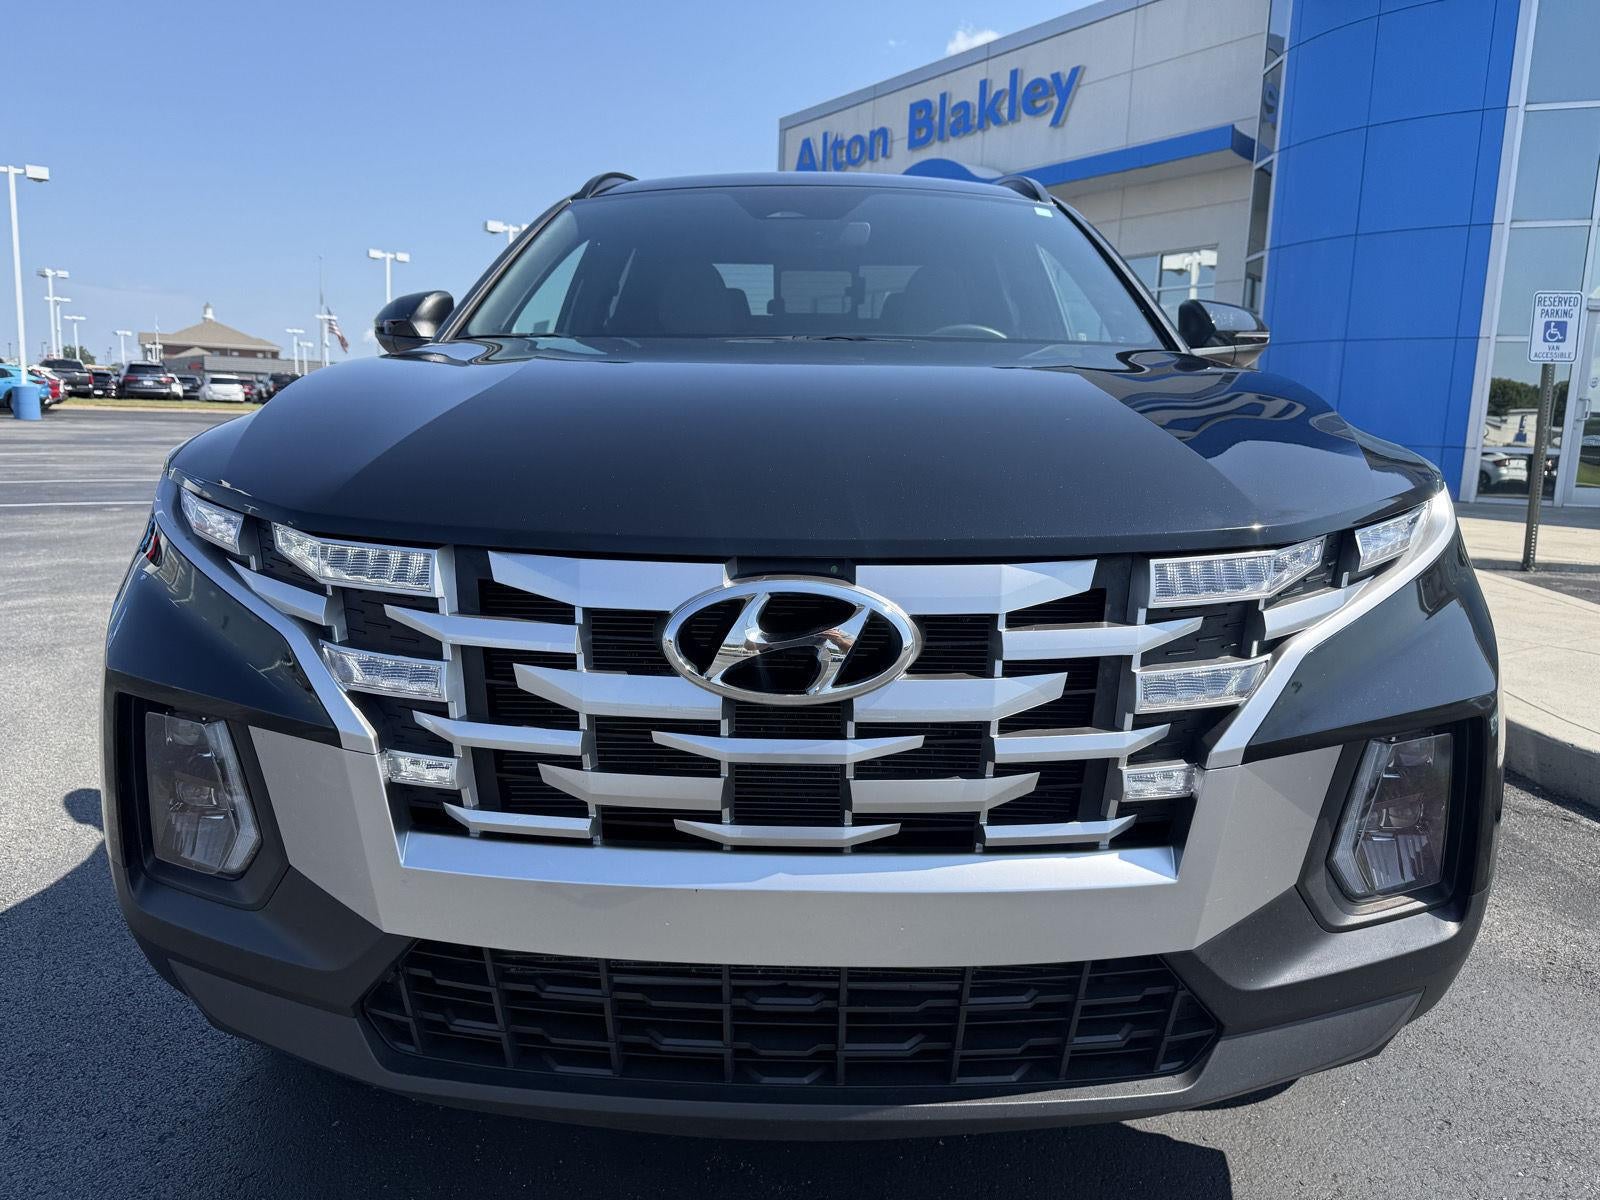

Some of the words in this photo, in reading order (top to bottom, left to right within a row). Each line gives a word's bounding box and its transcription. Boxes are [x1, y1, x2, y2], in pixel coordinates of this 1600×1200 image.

[795, 124, 891, 172] Alton
[907, 64, 1086, 151] Blakley
[1537, 296, 1579, 307] RESERVED
[1540, 308, 1573, 319] PARKING
[1533, 351, 1572, 359] ACCESSIBLE
